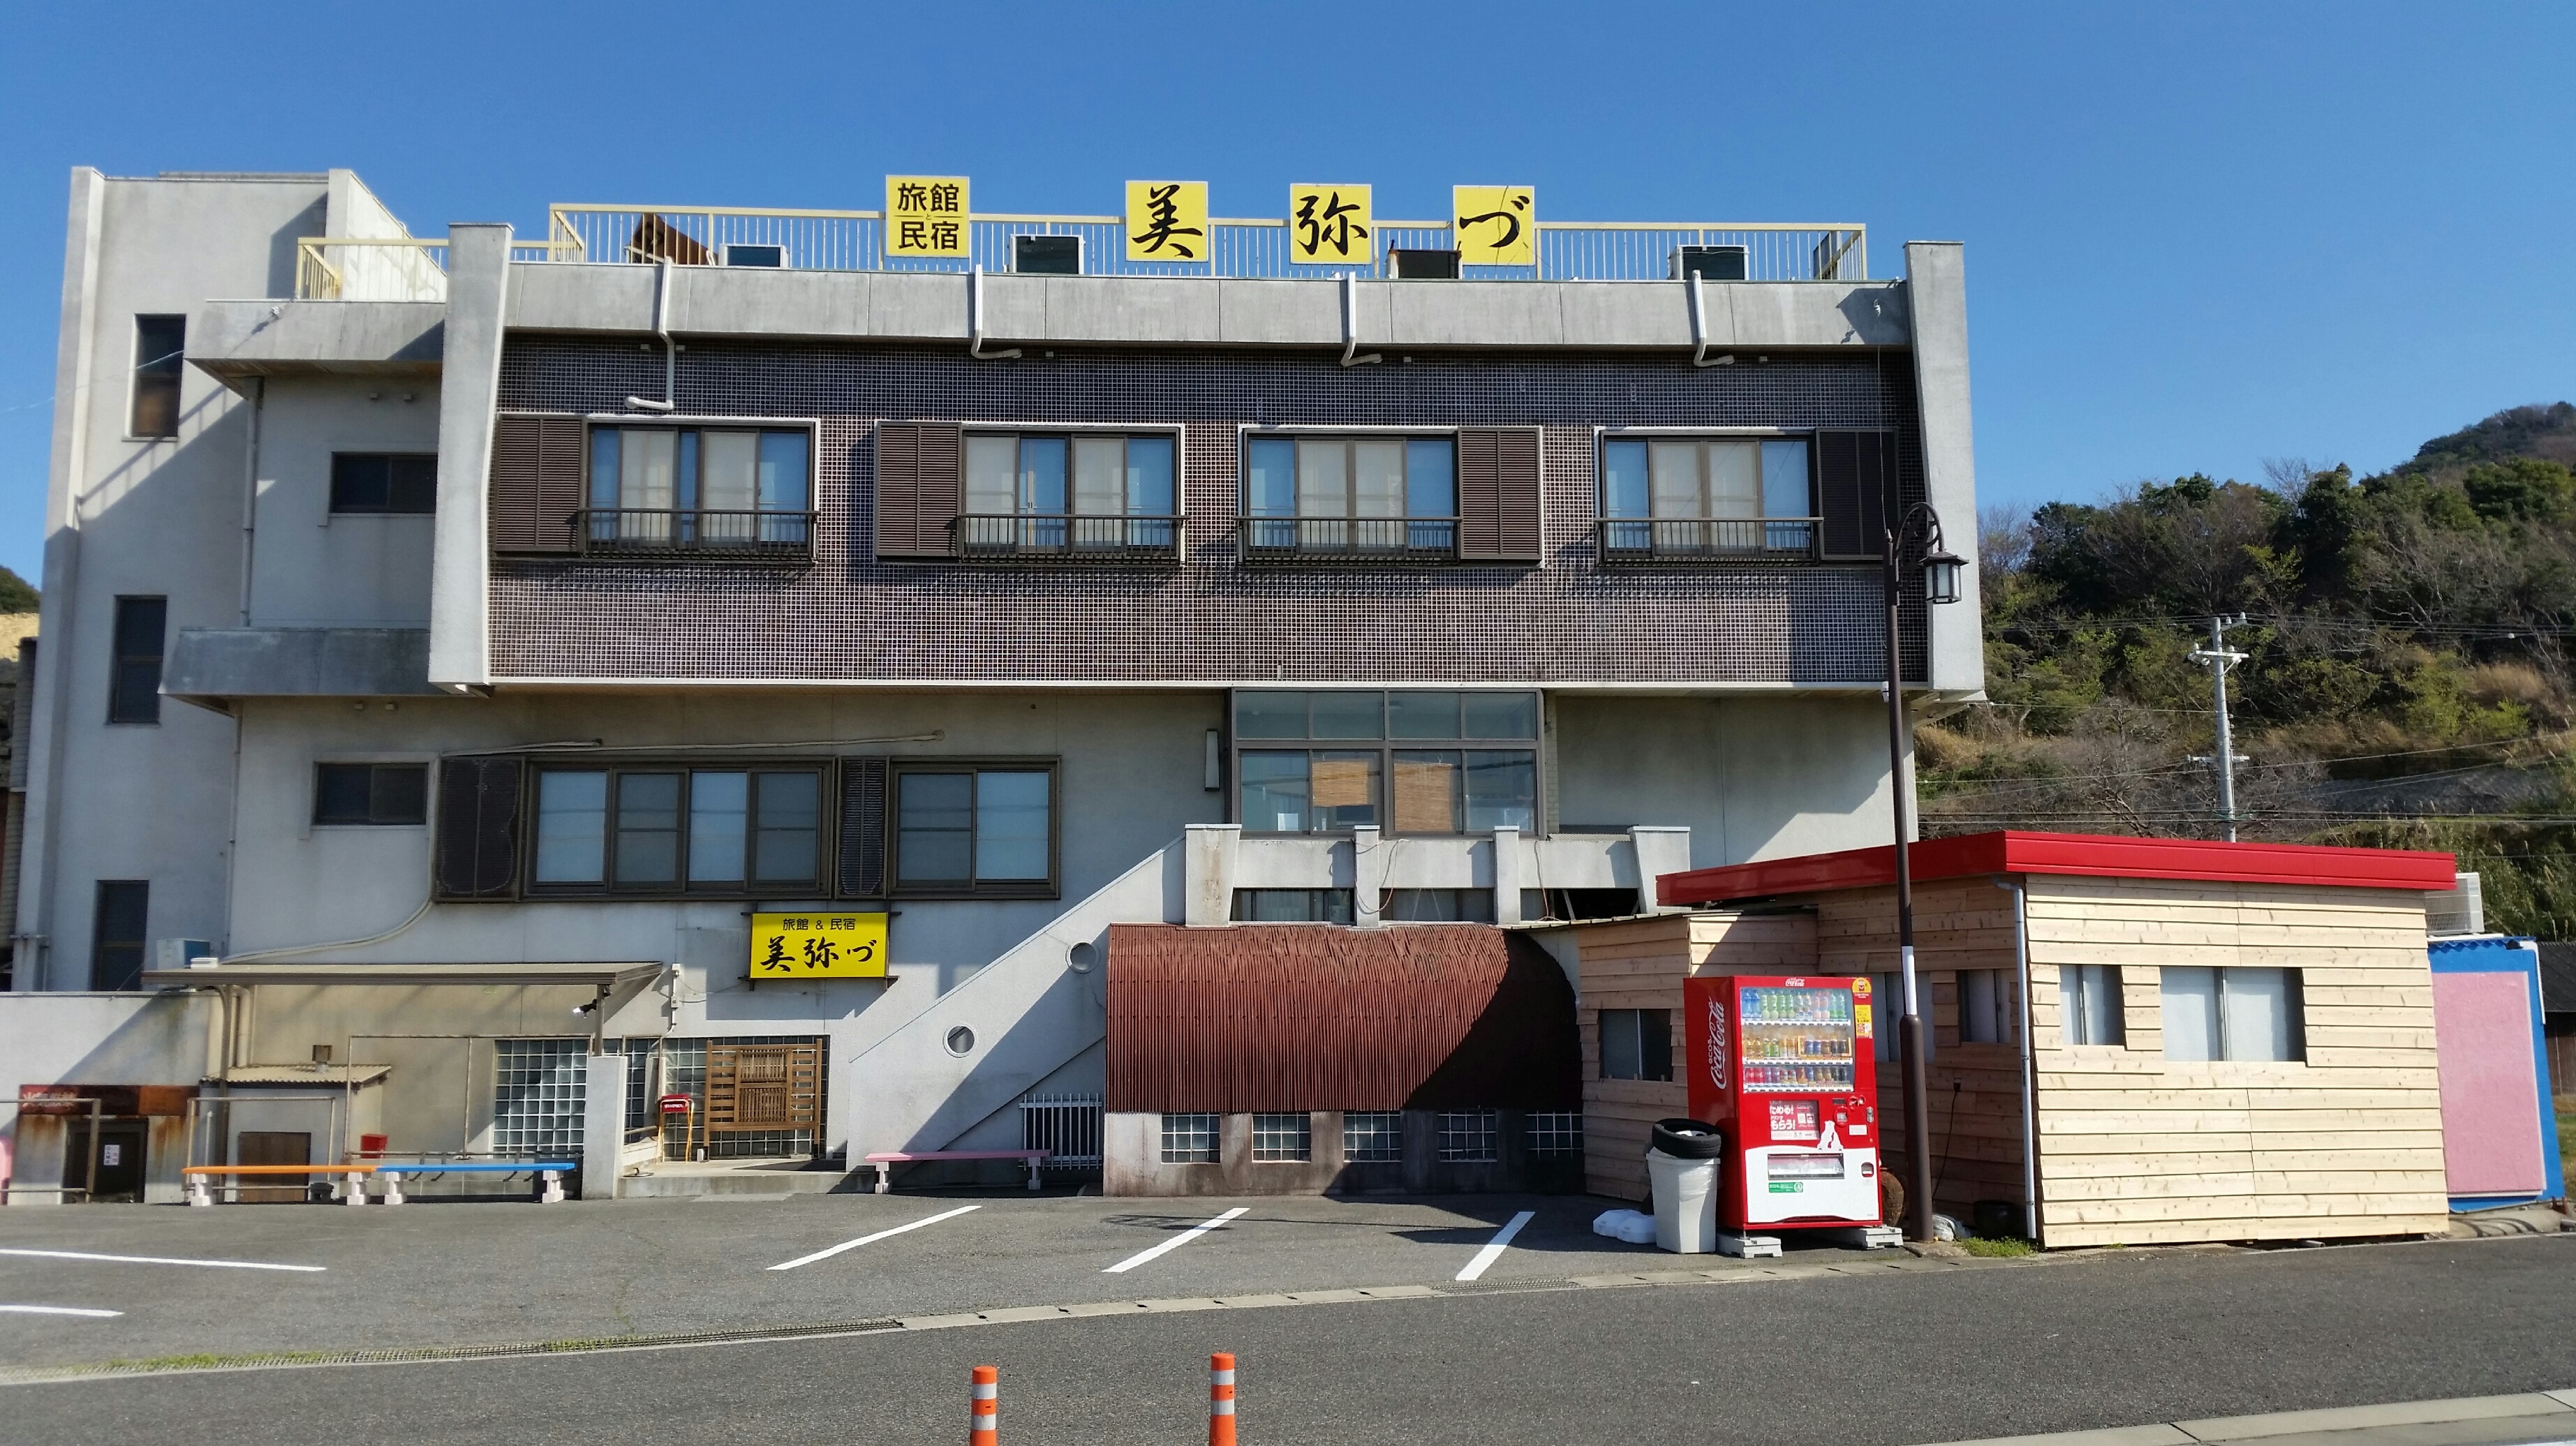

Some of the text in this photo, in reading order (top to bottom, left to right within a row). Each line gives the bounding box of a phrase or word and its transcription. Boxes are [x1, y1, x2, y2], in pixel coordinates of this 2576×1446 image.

[897, 183, 959, 212] 旅館
[898, 221, 959, 250] 民宿
[783, 918, 809, 931] 旅館
[830, 918, 856, 930] 民宿
[1708, 996, 1727, 1089] Coca-Cola
